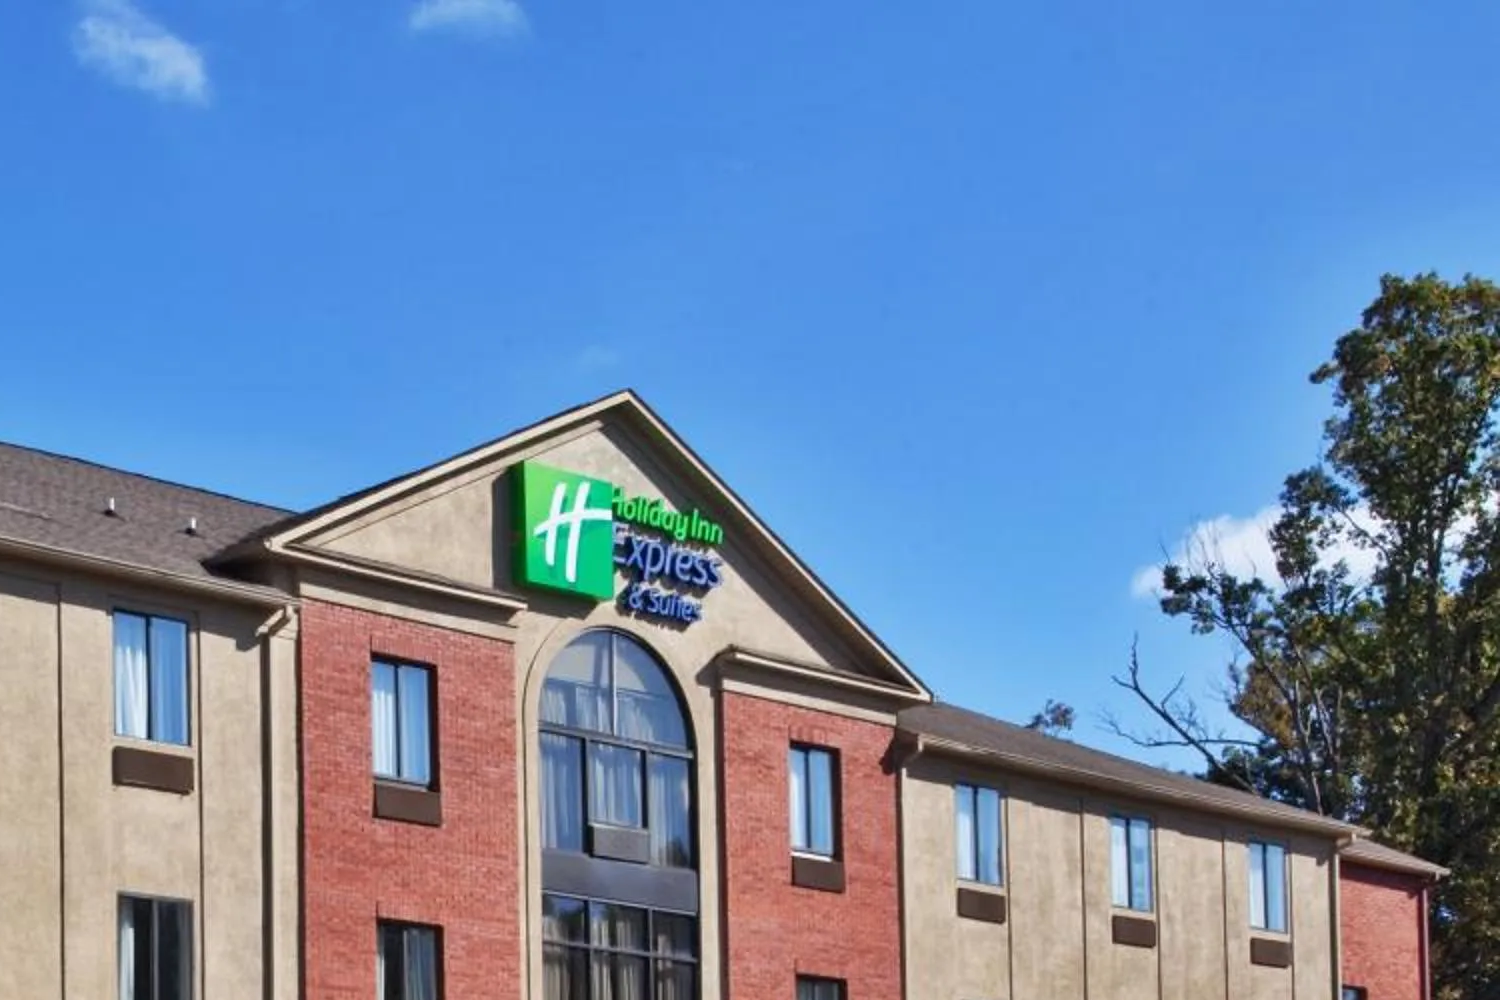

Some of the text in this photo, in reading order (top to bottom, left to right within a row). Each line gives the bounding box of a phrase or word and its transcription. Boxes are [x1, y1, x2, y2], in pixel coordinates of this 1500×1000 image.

[690, 508, 723, 544] Inn
[612, 521, 723, 588] Express
[628, 582, 704, 621] & Suites
